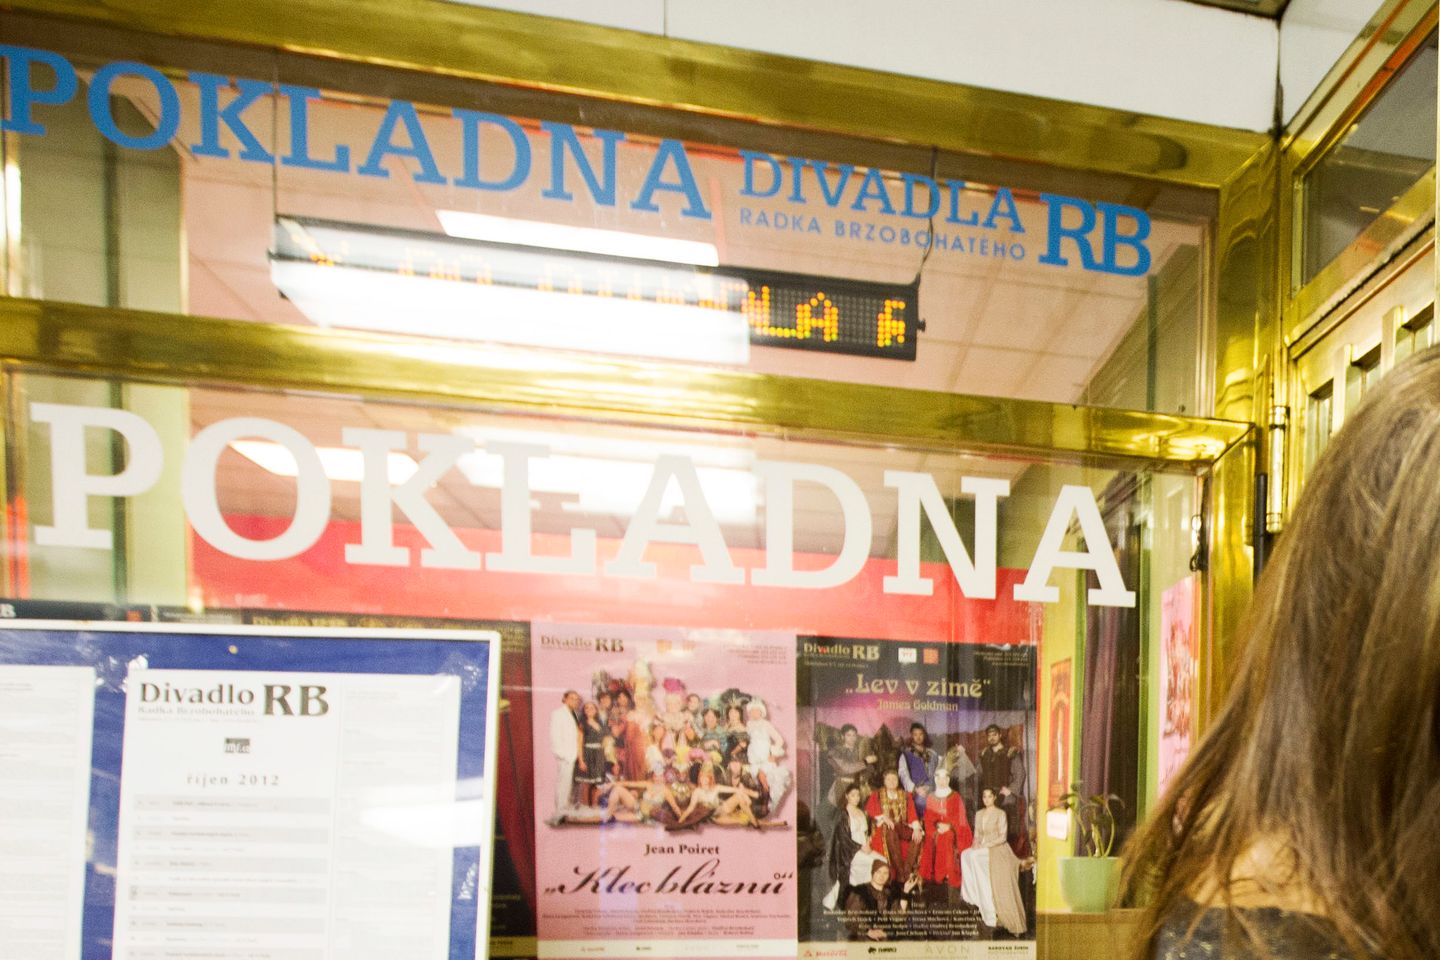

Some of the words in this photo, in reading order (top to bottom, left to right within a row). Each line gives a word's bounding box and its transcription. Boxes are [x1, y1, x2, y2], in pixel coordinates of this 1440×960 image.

[0, 43, 712, 221] POKLADNA
[738, 150, 1026, 233] DIVADLA
[1038, 192, 1153, 277] RB
[740, 207, 823, 234] RADKA
[834, 220, 1026, 261] BRZOBOHATÉHO
[30, 402, 1137, 609] POKLADNA
[540, 635, 593, 649] Divadlo
[594, 638, 625, 653] RB
[803, 642, 851, 655] Divadlo
[852, 644, 881, 662] RB
[140, 682, 255, 705] Divadlo
[263, 684, 330, 717] RB
[905, 680, 920, 695] v
[238, 773, 280, 787] 2012
[643, 843, 675, 856] Jean
[679, 843, 720, 855] Poiret
